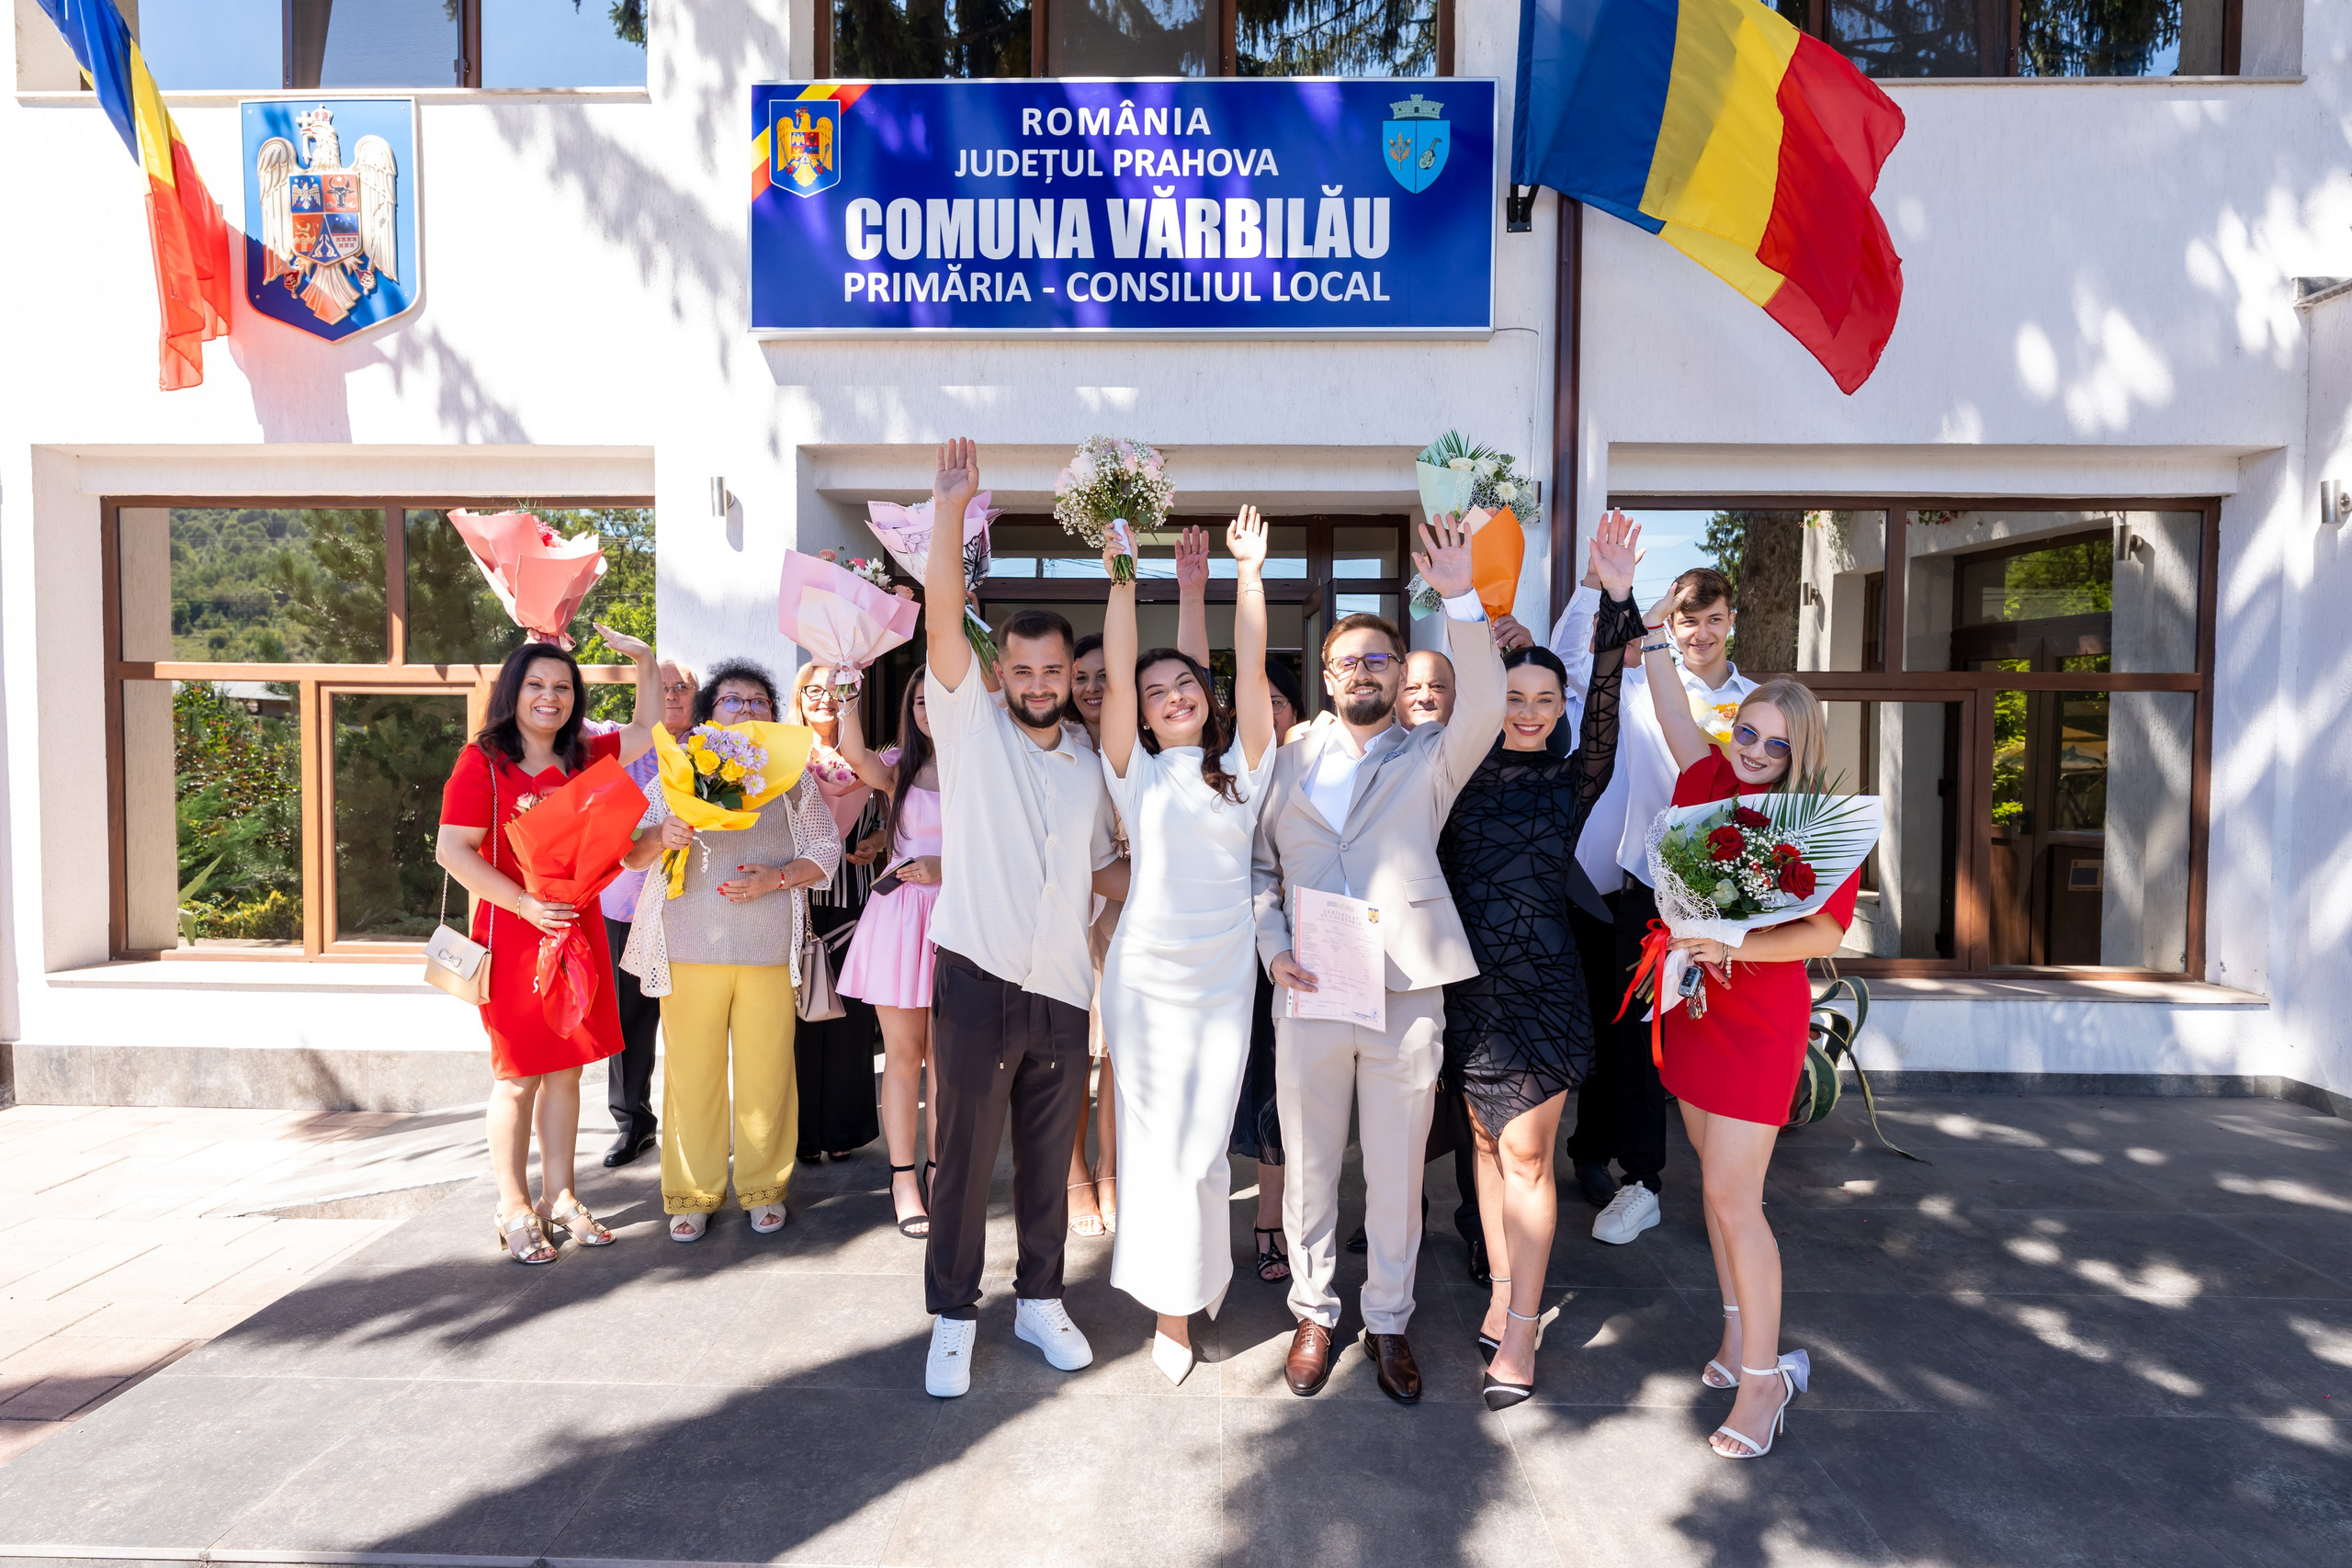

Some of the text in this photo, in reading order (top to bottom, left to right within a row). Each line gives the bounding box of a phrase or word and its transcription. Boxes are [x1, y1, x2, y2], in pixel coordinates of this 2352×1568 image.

[1022, 99, 1212, 136] ROMÂNIA
[955, 148, 1280, 184] JUDEȚUL PRAHOVA
[845, 184, 1391, 261] COMUNA VĂRBILĂU
[843, 264, 1032, 303] PRIMĂRIA
[1066, 271, 1261, 303] CONSILIUL
[1273, 271, 1391, 303] LOCAL
